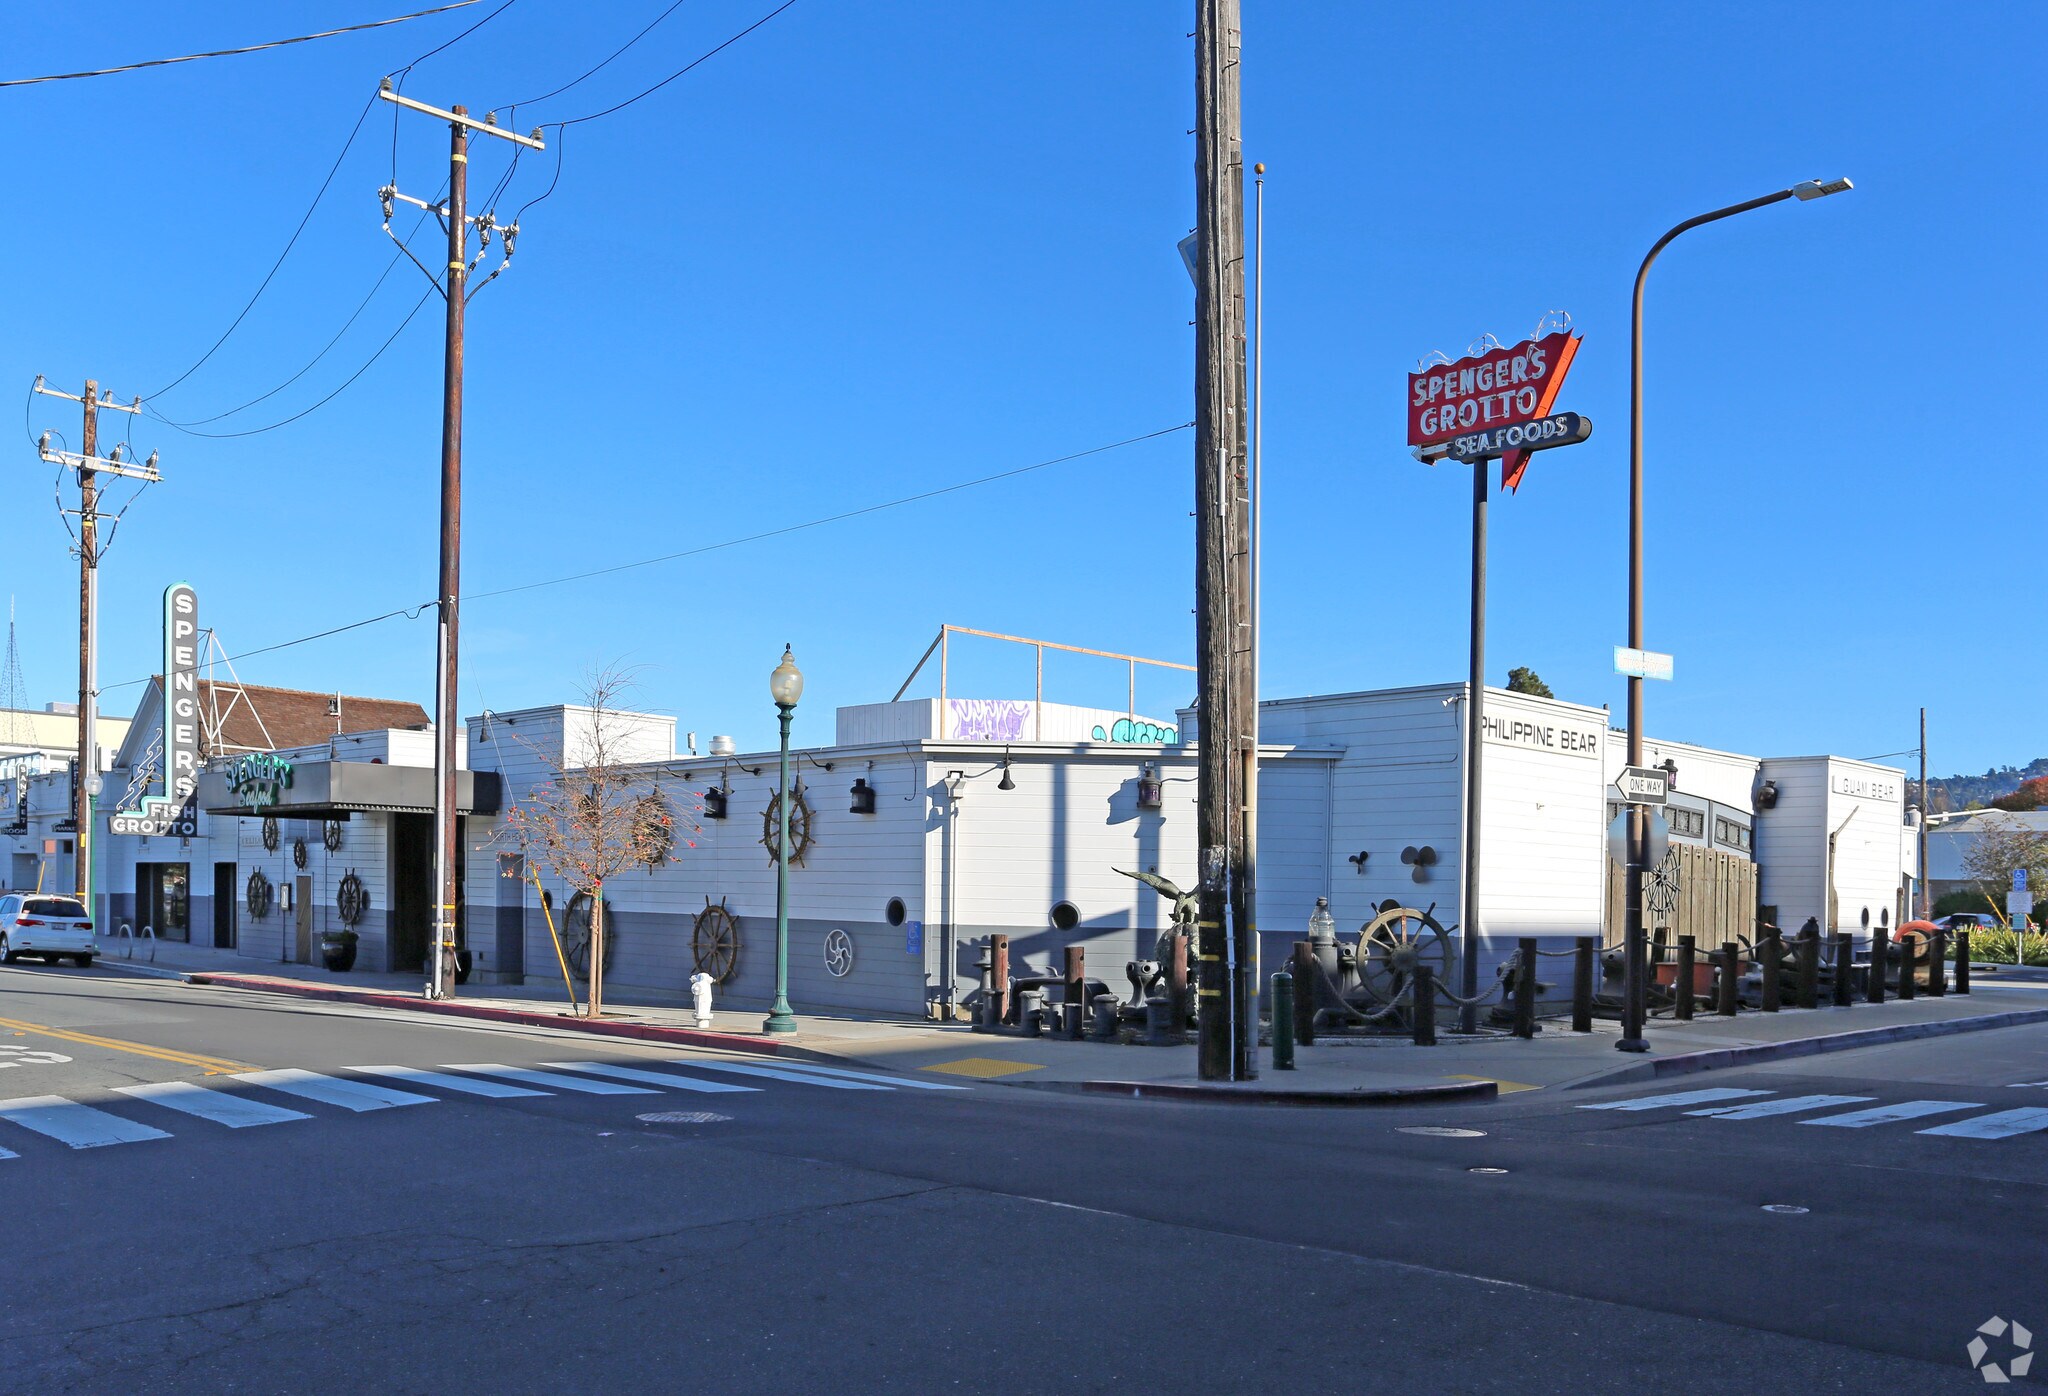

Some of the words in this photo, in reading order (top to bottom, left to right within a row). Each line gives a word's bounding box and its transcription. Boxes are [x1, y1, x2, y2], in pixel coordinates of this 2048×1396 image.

[1413, 345, 1547, 406] SPENGER'S
[1420, 386, 1537, 435] GROTTO
[1454, 433, 1490, 456] SEA
[1496, 417, 1568, 449] FOODS
[175, 594, 196, 797] SPENGER'S
[1482, 716, 1554, 747] PHILIPPINE
[1561, 730, 1597, 754] BEAR
[240, 783, 274, 814] Seafood
[1630, 778, 1645, 792] ONE
[1646, 780, 1663, 794] WAY
[1872, 783, 1894, 799] BEAR
[113, 818, 195, 835] GROTTO
[151, 804, 194, 819] FISH
